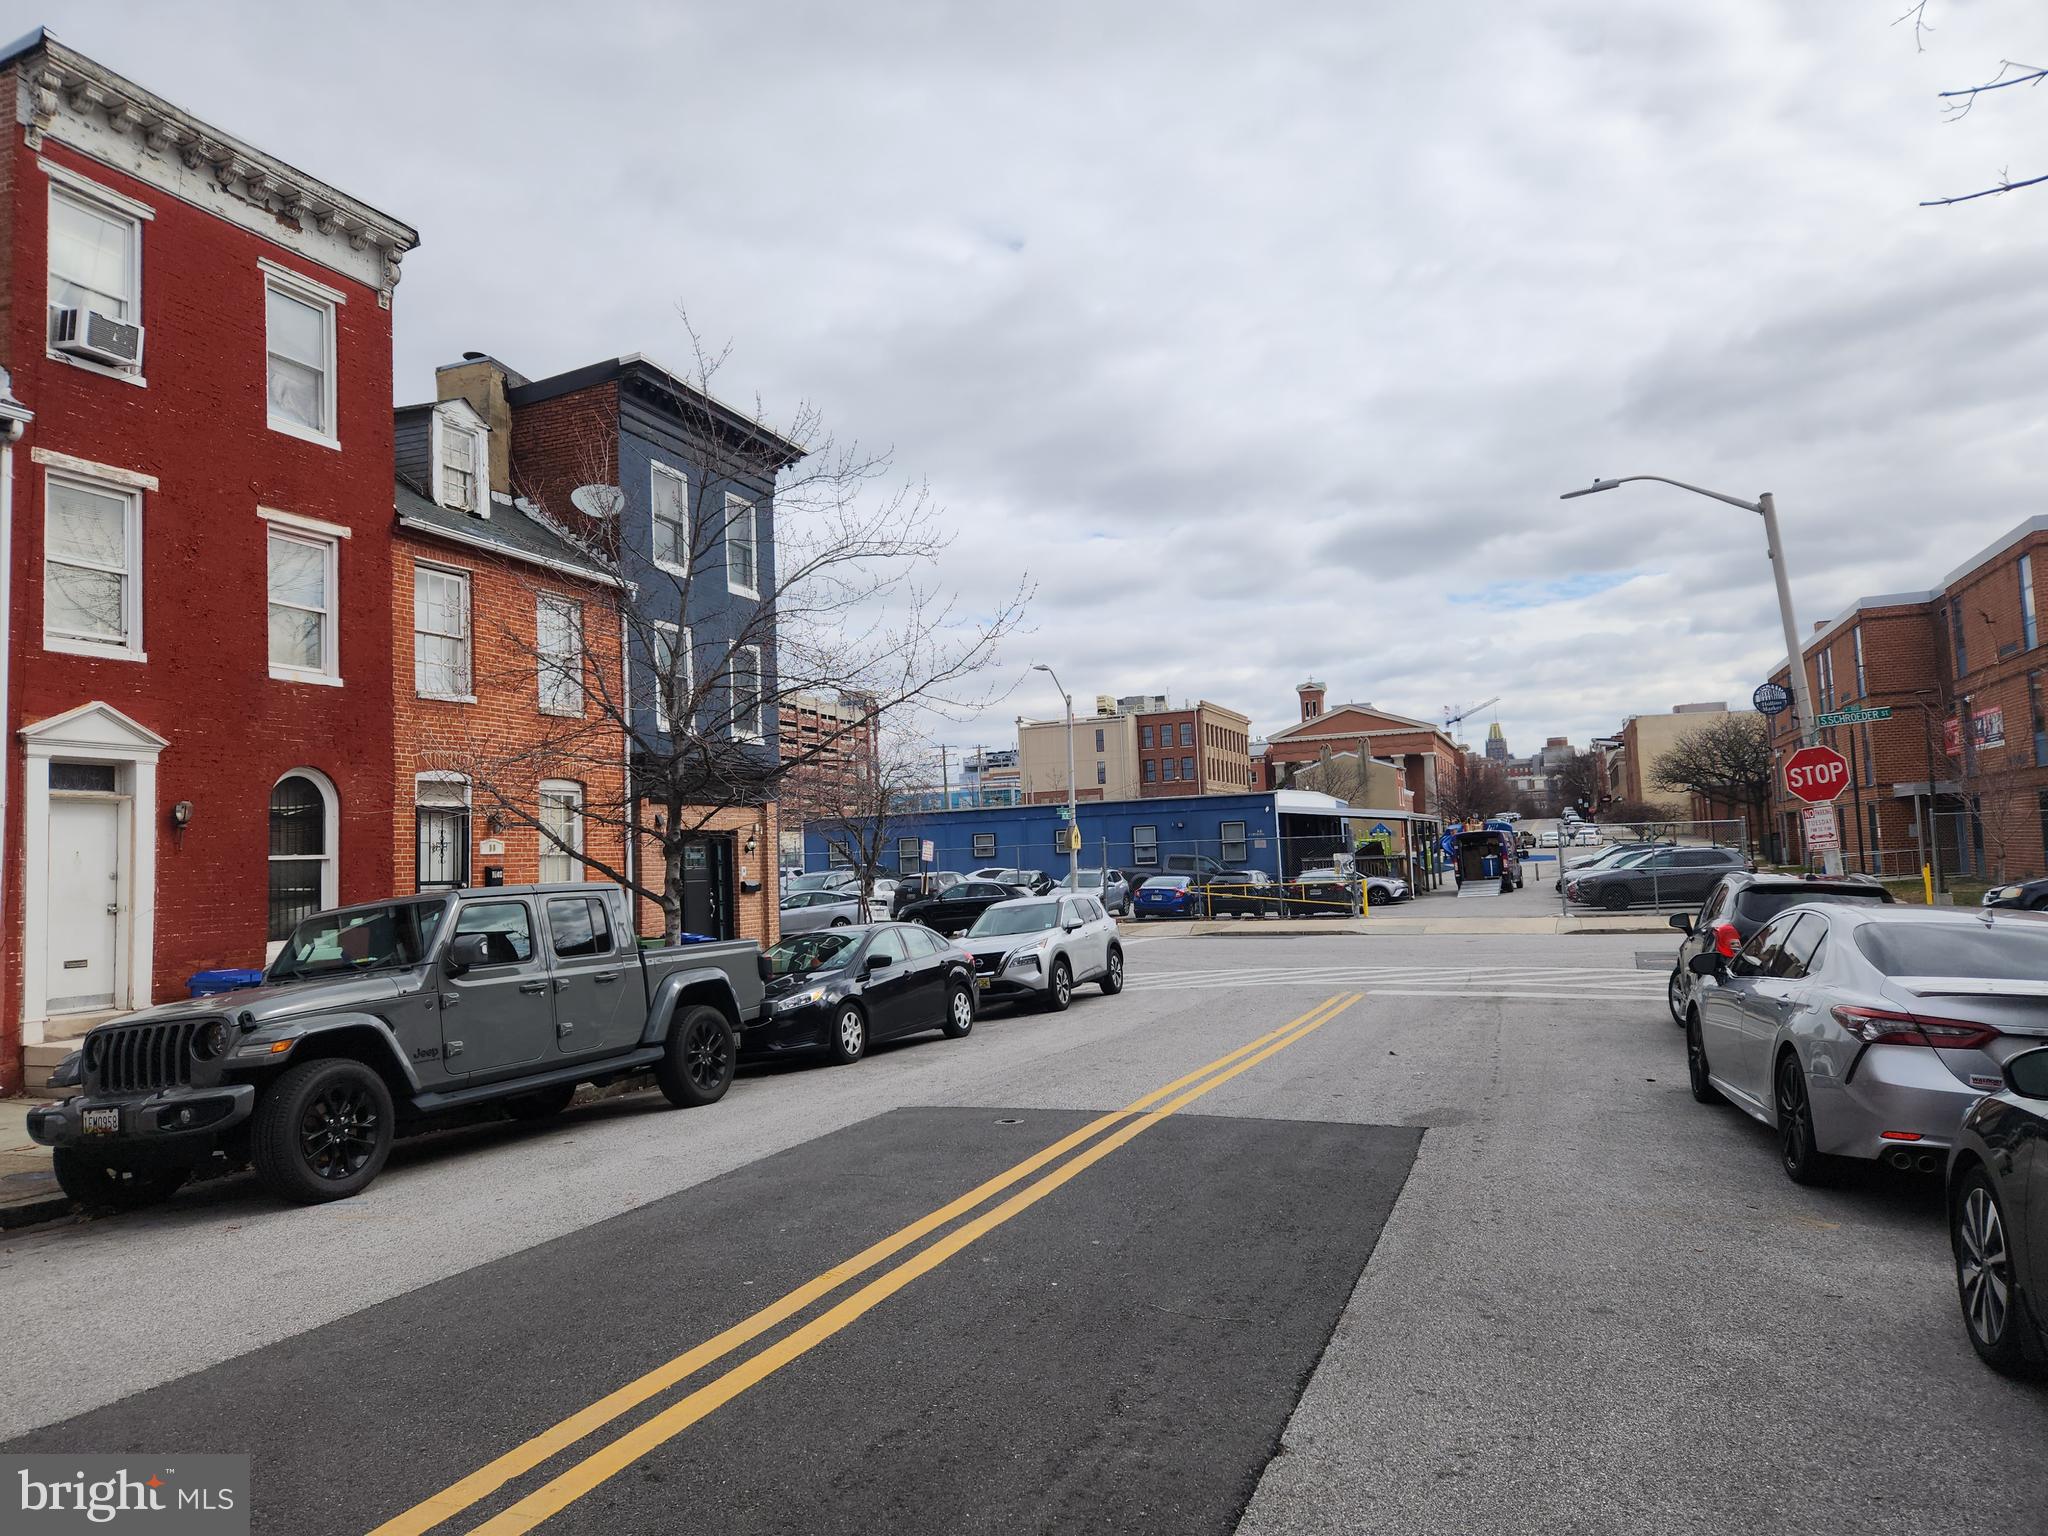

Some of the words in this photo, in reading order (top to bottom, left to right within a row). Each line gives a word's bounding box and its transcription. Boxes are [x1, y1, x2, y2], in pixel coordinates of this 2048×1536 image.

[1828, 710, 1879, 724] SCHROEDER
[1790, 762, 1843, 787] STOP
[1804, 809, 1814, 818] NO
[413, 1048, 439, 1058] Jeep
